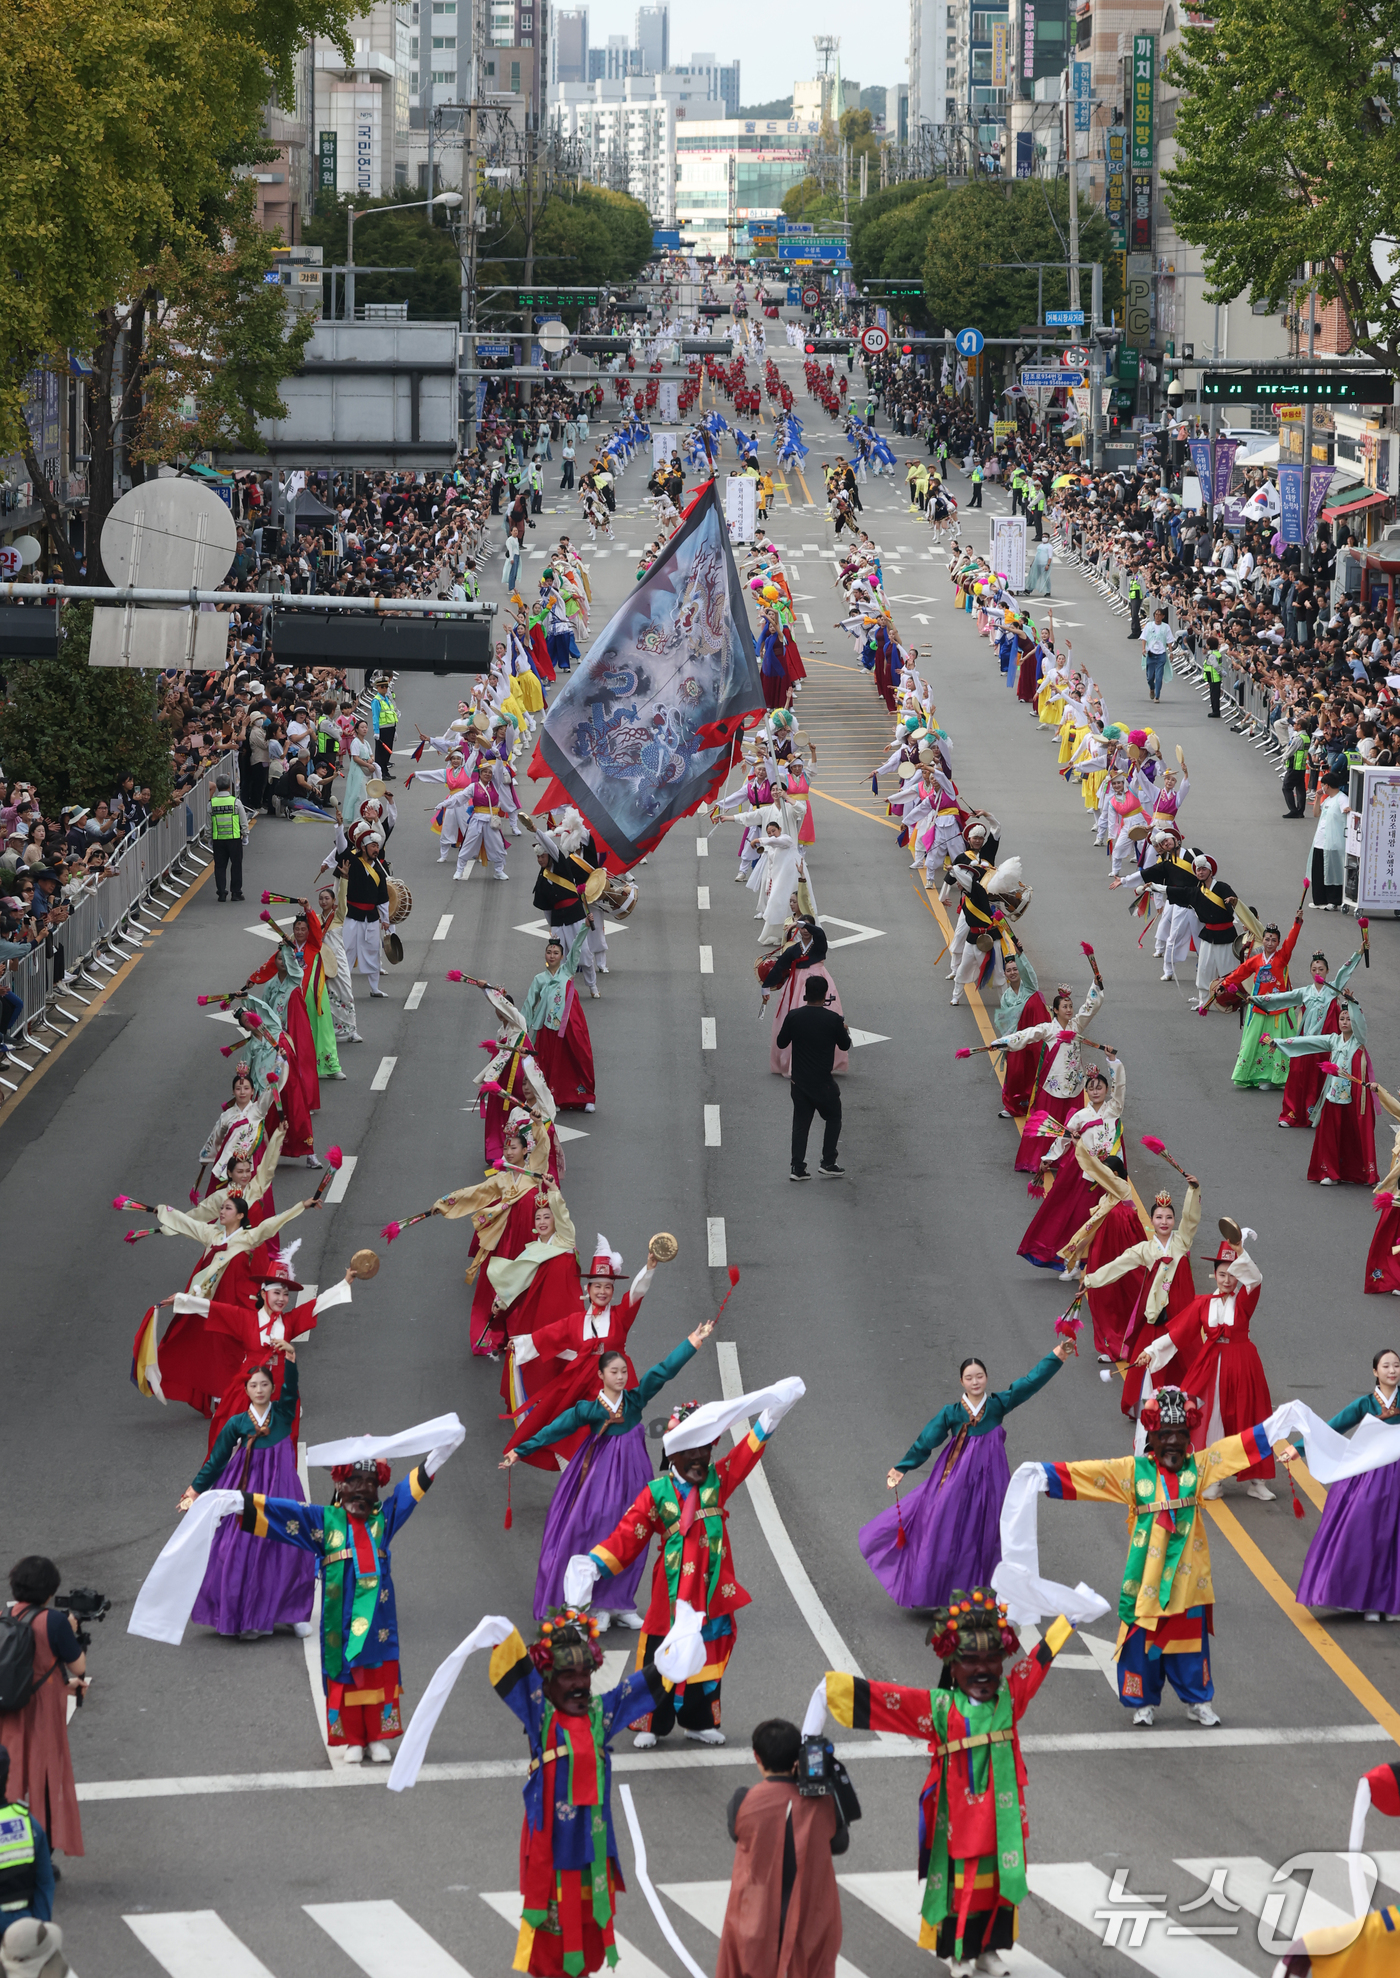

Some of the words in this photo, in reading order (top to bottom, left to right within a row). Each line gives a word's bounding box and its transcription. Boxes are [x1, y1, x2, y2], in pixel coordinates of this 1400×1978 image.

[1136, 39, 1151, 79] 까치
[1136, 82, 1151, 145] 만화방
[744, 121, 819, 133] 월드타워
[357, 125, 371, 188] 국민연금
[1135, 147, 1149, 158] 1층
[322, 142, 335, 184] 한의원
[1108, 162, 1124, 172] PC
[1135, 176, 1149, 185] 4F
[1134, 186, 1150, 194] 수원
[1136, 195, 1149, 219] 동양
[806, 293, 816, 301] 50
[1129, 280, 1150, 334] PC
[1047, 313, 1084, 323] 거북시장사거리
[867, 334, 883, 345] 50
[1023, 373, 1063, 381] 정조로934번길
[1281, 410, 1302, 419] 부동산
[1388, 813, 1397, 847] 정조대왕
[1386, 850, 1396, 877] 능행차
[0, 1833, 24, 1844] OLICE
